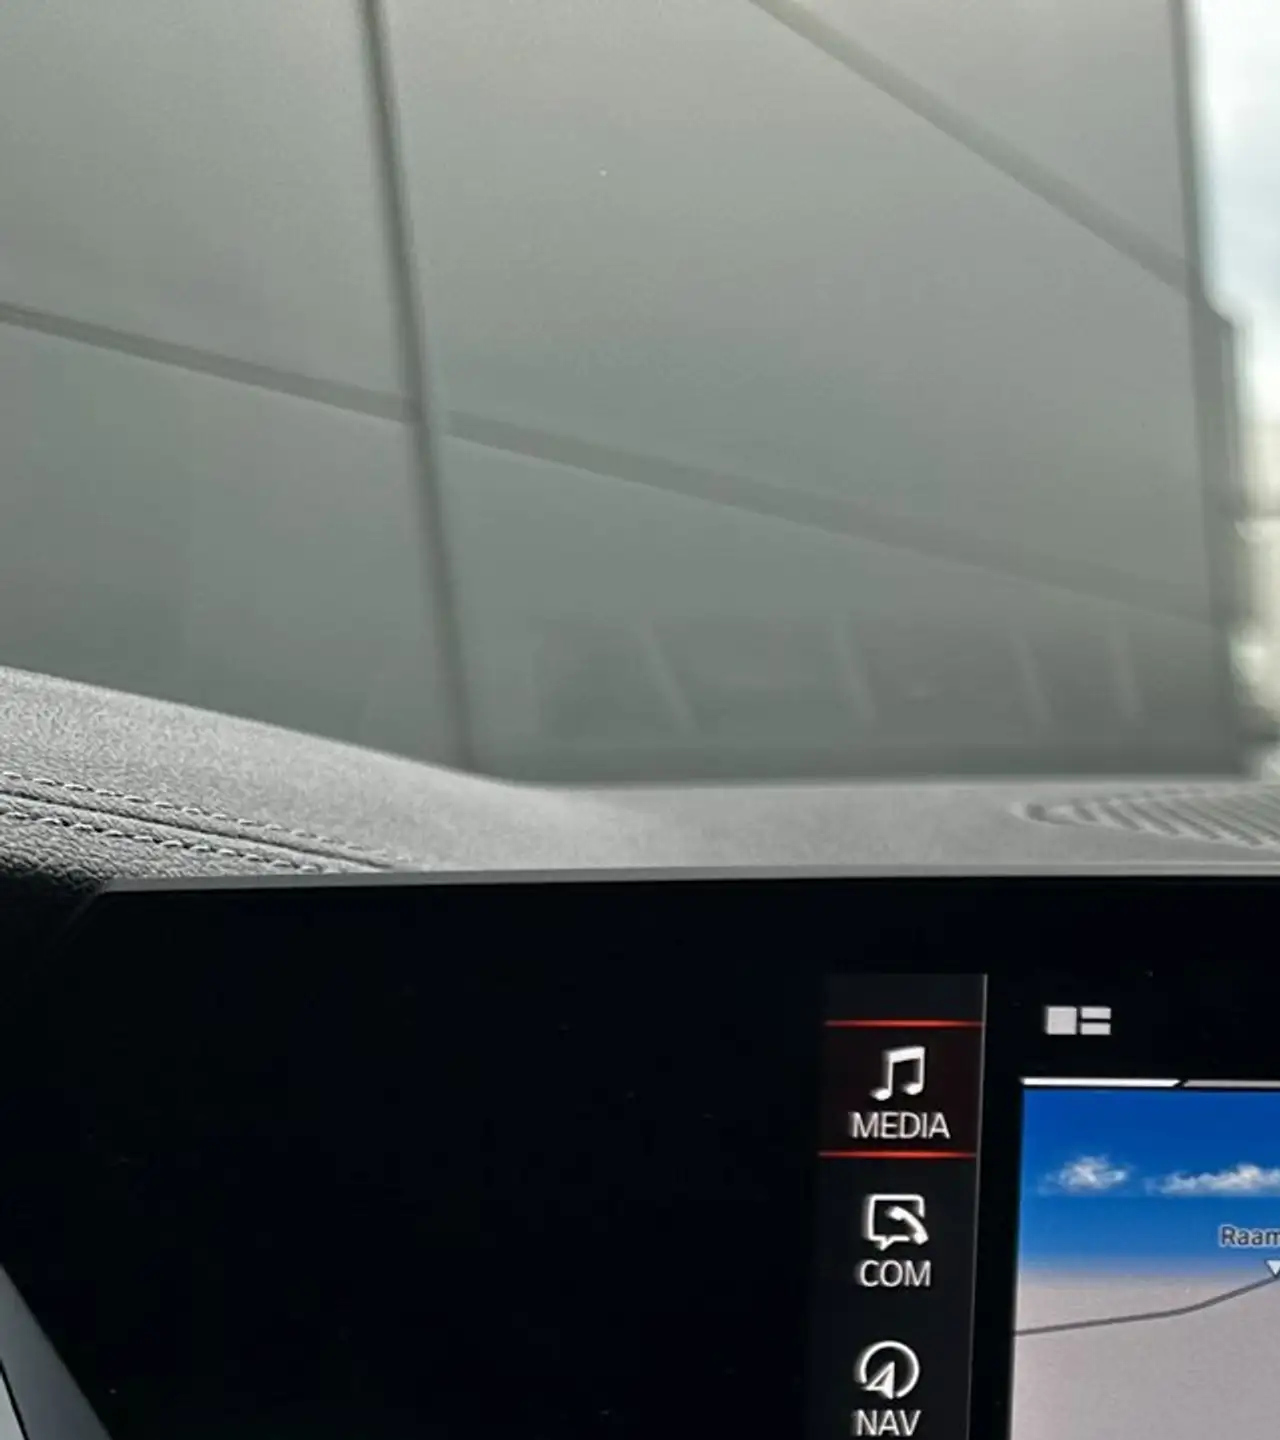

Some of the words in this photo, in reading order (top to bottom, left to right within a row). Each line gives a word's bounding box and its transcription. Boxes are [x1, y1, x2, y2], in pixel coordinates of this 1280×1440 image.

[849, 1111, 950, 1140] MEDIA
[857, 1260, 931, 1288] COM
[854, 1410, 921, 1437] NAV
